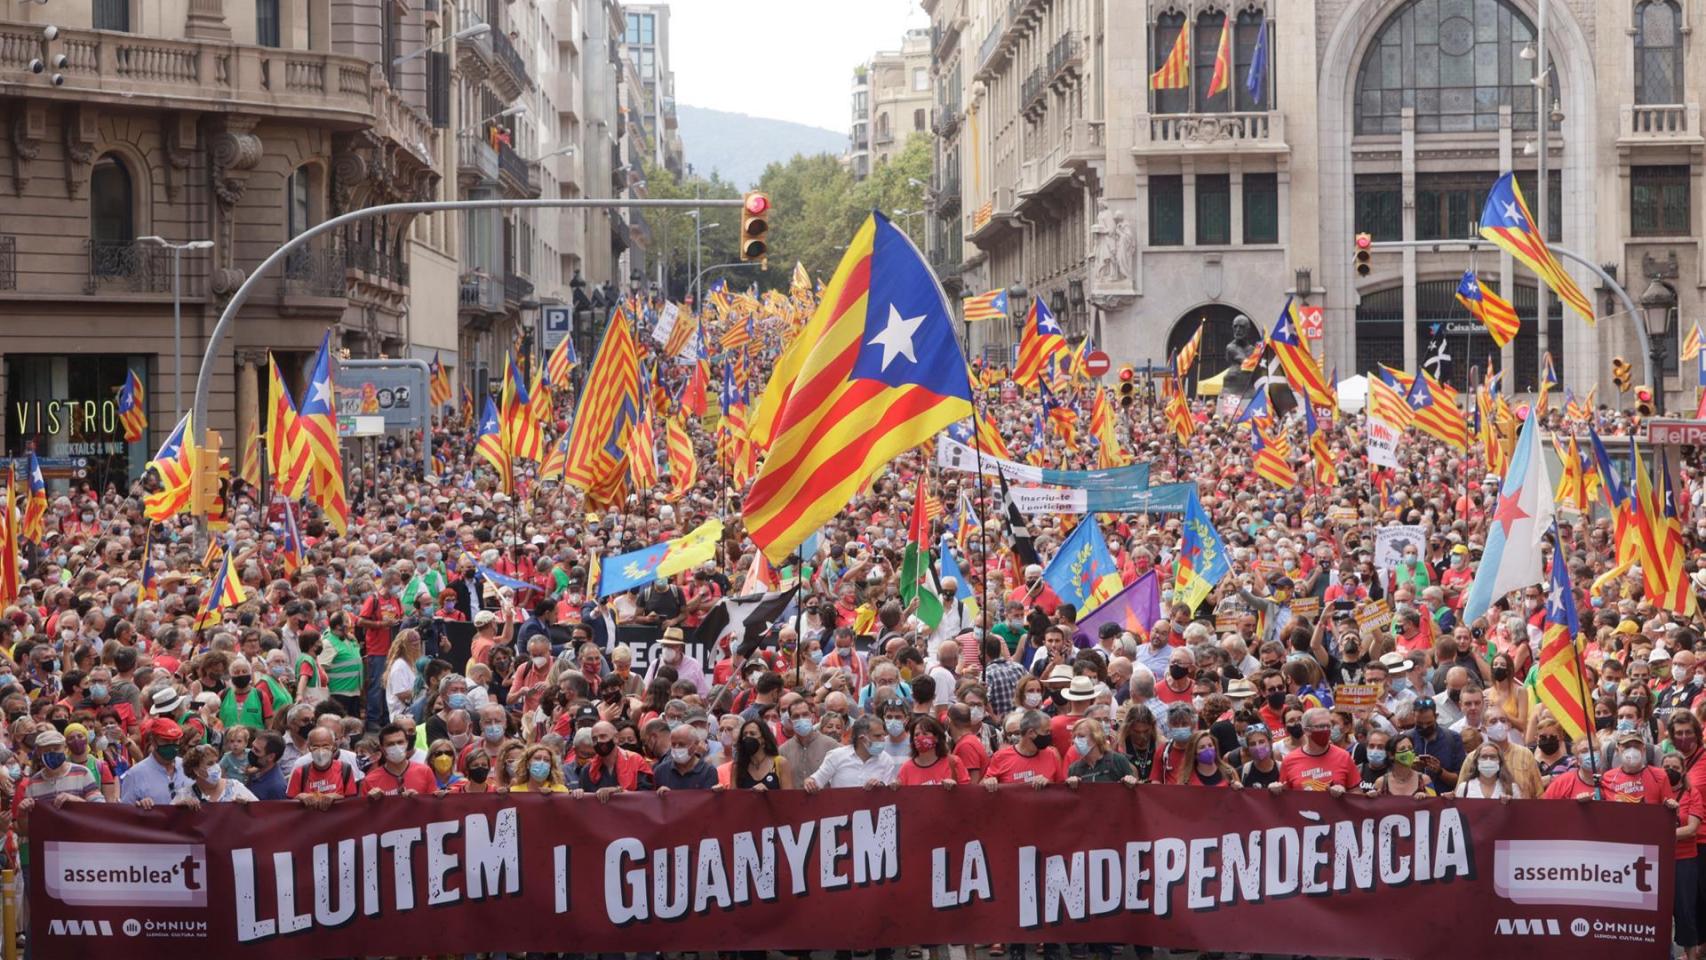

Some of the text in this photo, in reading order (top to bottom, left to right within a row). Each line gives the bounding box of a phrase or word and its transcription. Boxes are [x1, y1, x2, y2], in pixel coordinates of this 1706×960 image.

[550, 311, 565, 328] P
[16, 400, 115, 436] VISTRO
[1316, 407, 1332, 417] 10
[54, 442, 96, 455] COCKTAILS
[231, 804, 1470, 942] LLUITEM I GUANYEM LA INDEPENDÈNCIA
[145, 918, 208, 931] ÒMNIUM
[1593, 918, 1656, 935] ÒMNIUM
